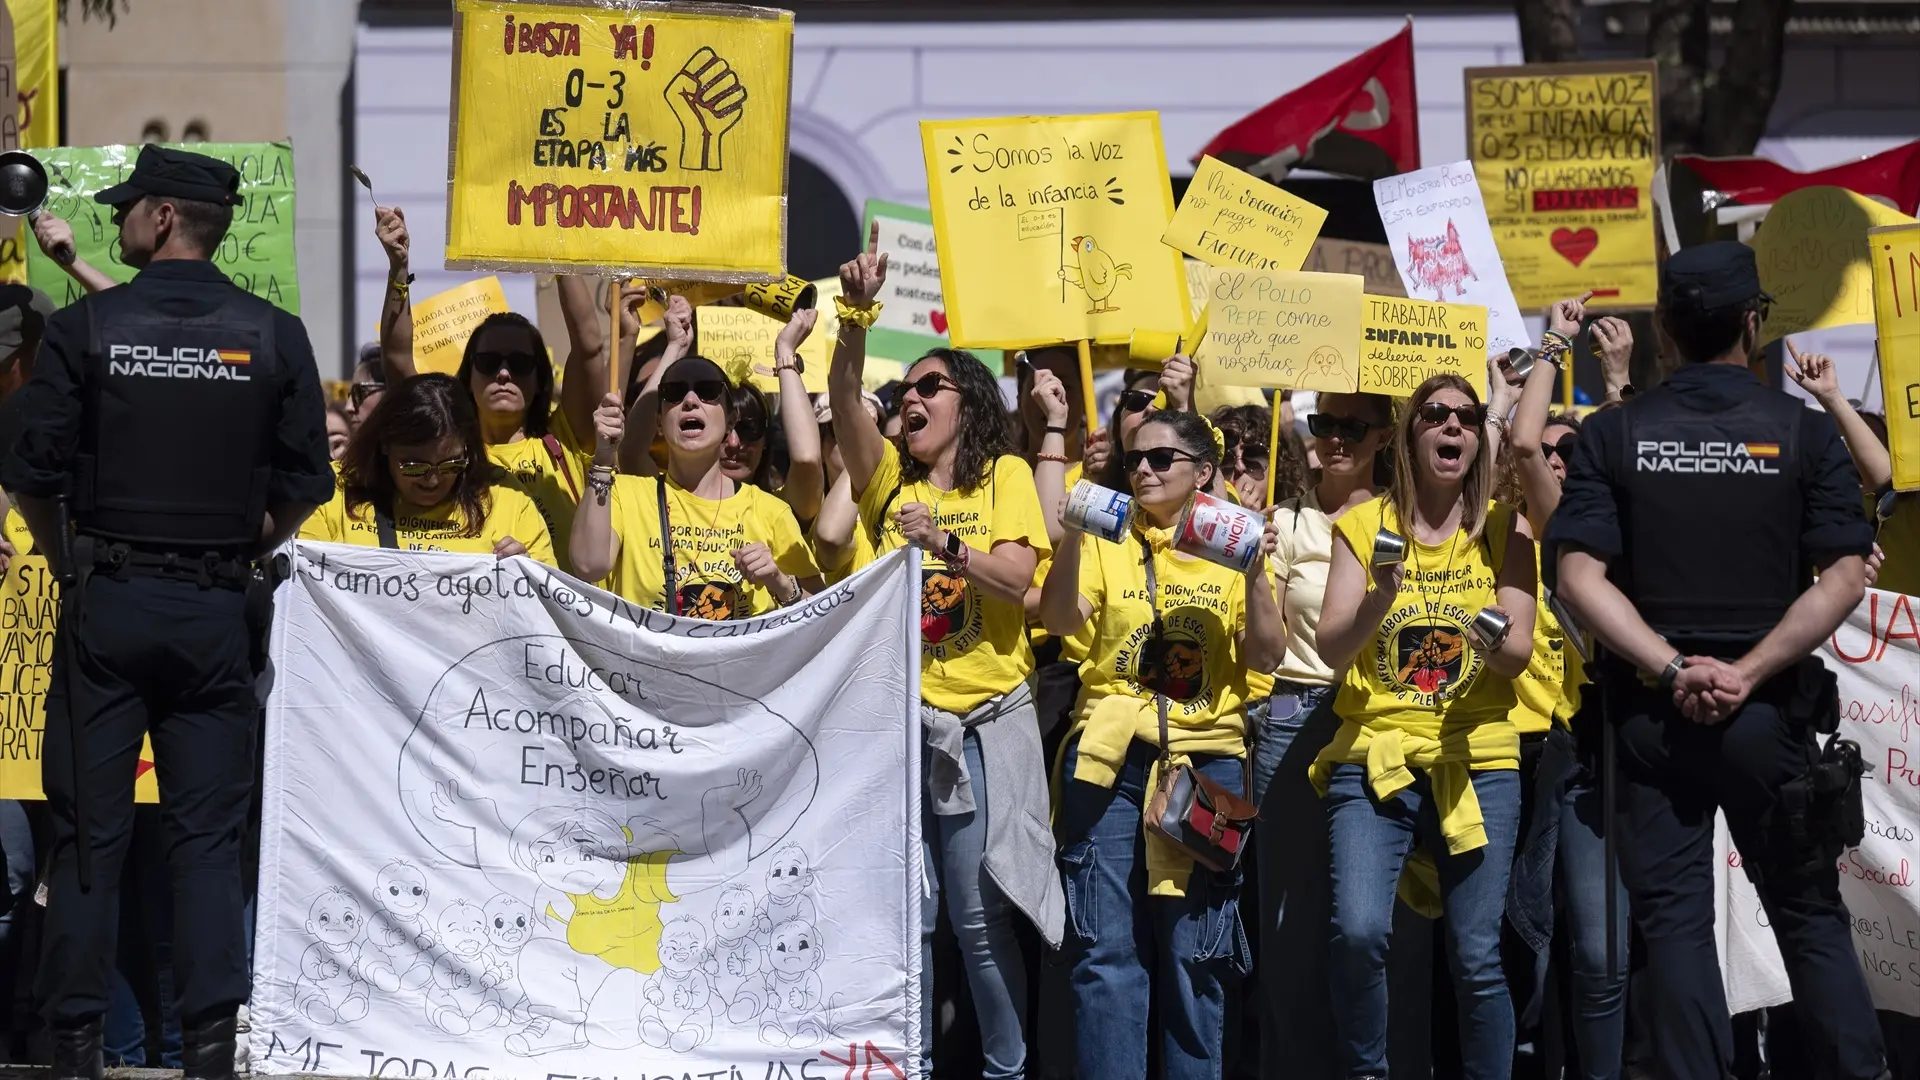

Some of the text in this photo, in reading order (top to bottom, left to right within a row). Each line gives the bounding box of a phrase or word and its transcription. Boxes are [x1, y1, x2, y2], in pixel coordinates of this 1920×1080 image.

[504, 15, 654, 70] ¡BASTA YA!
[565, 68, 626, 109] 0-3
[1477, 78, 1572, 109] SOMOS
[540, 107, 630, 141] ES LA
[534, 139, 668, 172] ETAPA MÁS
[972, 133, 1053, 173] Somos
[1063, 137, 1084, 161] la
[969, 183, 1099, 211] de la infancia
[1239, 189, 1303, 230] vocación
[1190, 194, 1295, 248] no paga mis
[1215, 271, 1245, 301] El
[413, 308, 444, 328] AJADA
[459, 293, 491, 310] RATIOS
[701, 313, 754, 326] CUIDAR
[1276, 310, 1331, 328] come
[1370, 300, 1478, 332] TRABAJAR en
[420, 321, 452, 340] PUEDE
[703, 330, 770, 341] INFANCIA
[1211, 329, 1301, 355] mejor que
[1365, 327, 1485, 349] INFANTIL NO
[110, 345, 223, 363] POLICIA
[422, 344, 434, 355] ES
[1436, 356, 1461, 367] ser
[110, 361, 251, 381] NACIONAL
[1217, 350, 1297, 377] nosotras
[1637, 441, 1750, 457] POLICIA
[1637, 457, 1780, 475] NACIONAL
[351, 523, 363, 531] LA
[933, 513, 979, 526] NIFICAR
[1215, 511, 1230, 524] 2
[649, 537, 660, 548] LA
[670, 526, 691, 536] POR
[1222, 512, 1247, 558] NIDINA
[1415, 565, 1472, 582] DIGNIFICAR
[1418, 580, 1474, 594] EDUCATIVA
[1476, 577, 1492, 589] 0-3
[1123, 589, 1135, 599] LA
[2, 597, 61, 630] BAJA
[1168, 616, 1180, 628] DE
[1380, 604, 1421, 638] LABORAL
[525, 643, 648, 700] Educar
[464, 686, 684, 755] Acompañar
[521, 745, 668, 801] Enseñar
[1863, 819, 1914, 842] rias
[1848, 849, 1914, 887] Social
[1850, 913, 1920, 951] R@S LE
[1863, 949, 1901, 981] NOS
